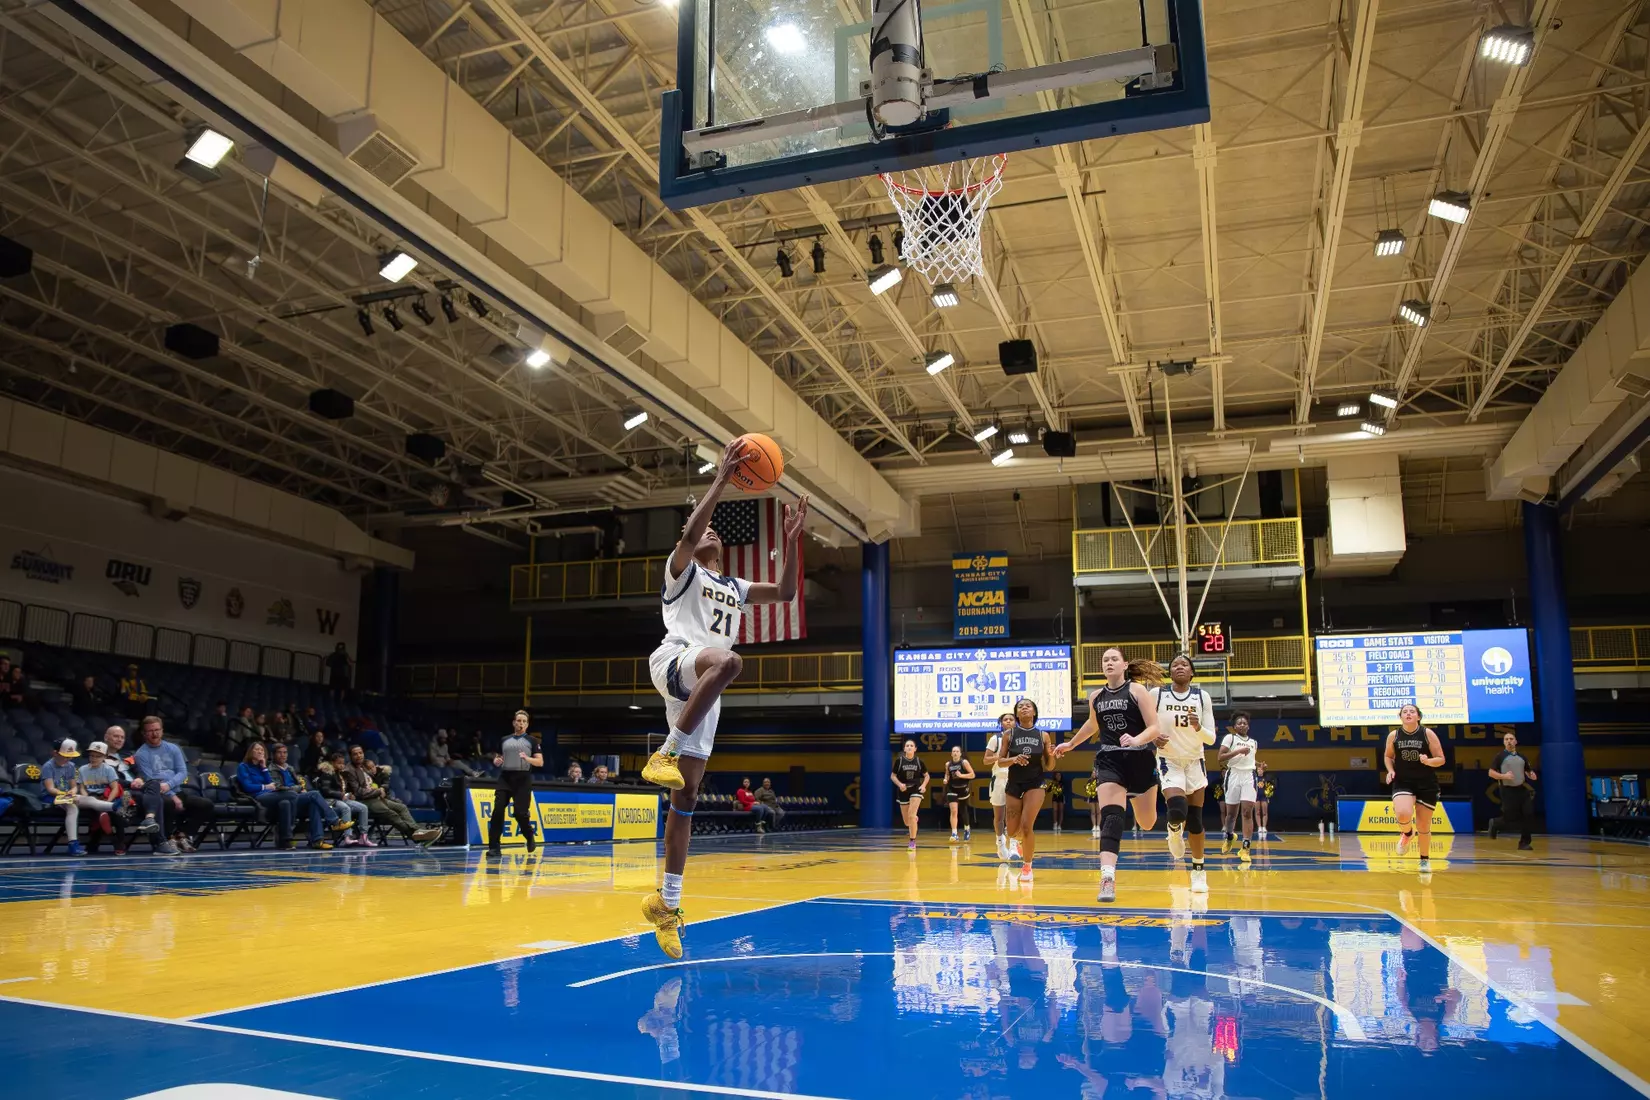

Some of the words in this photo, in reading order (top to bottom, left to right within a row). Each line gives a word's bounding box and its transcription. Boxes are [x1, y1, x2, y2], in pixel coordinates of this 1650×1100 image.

[10, 556, 74, 580] SUMMIT
[105, 559, 152, 586] ORU
[957, 590, 1005, 607] NCAA
[957, 606, 1005, 617] TOURNAMENT
[316, 608, 340, 635] W
[710, 608, 733, 637] 21
[958, 625, 1005, 636] 2019-2020
[1199, 624, 1222, 636] 51.6
[1204, 634, 1224, 652] 28
[1319, 639, 1354, 649] ROOS
[1363, 637, 1388, 647] GAME
[1388, 636, 1414, 646] STATS
[1423, 635, 1451, 645] VISITOR
[898, 653, 942, 661] KANSAS
[945, 652, 972, 660] CITY
[989, 649, 1066, 659] BASKETBALL
[1368, 651, 1388, 661] FIELD
[1388, 650, 1411, 660] GOALS
[1376, 663, 1395, 672] 3-PT
[1395, 663, 1404, 671] FG
[942, 674, 960, 692] 88
[1003, 673, 1021, 691] 25
[1367, 674, 1385, 684] FREE
[1385, 674, 1415, 683] THROWS
[1472, 676, 1524, 687] university
[1373, 687, 1410, 697] REBOUNDS
[1485, 685, 1514, 695] health
[1096, 698, 1129, 713] FALCONS
[1166, 704, 1197, 713] ROOS
[1372, 699, 1411, 709] TURNOVERS
[1103, 713, 1128, 731] 35
[1174, 714, 1188, 728] 13
[1015, 736, 1040, 746] FALCONS
[1398, 740, 1423, 749] FALCONS
[1401, 750, 1420, 761] 20
[544, 814, 578, 824] KCROOS.STORE
[617, 808, 656, 824] KCROOS.COM
